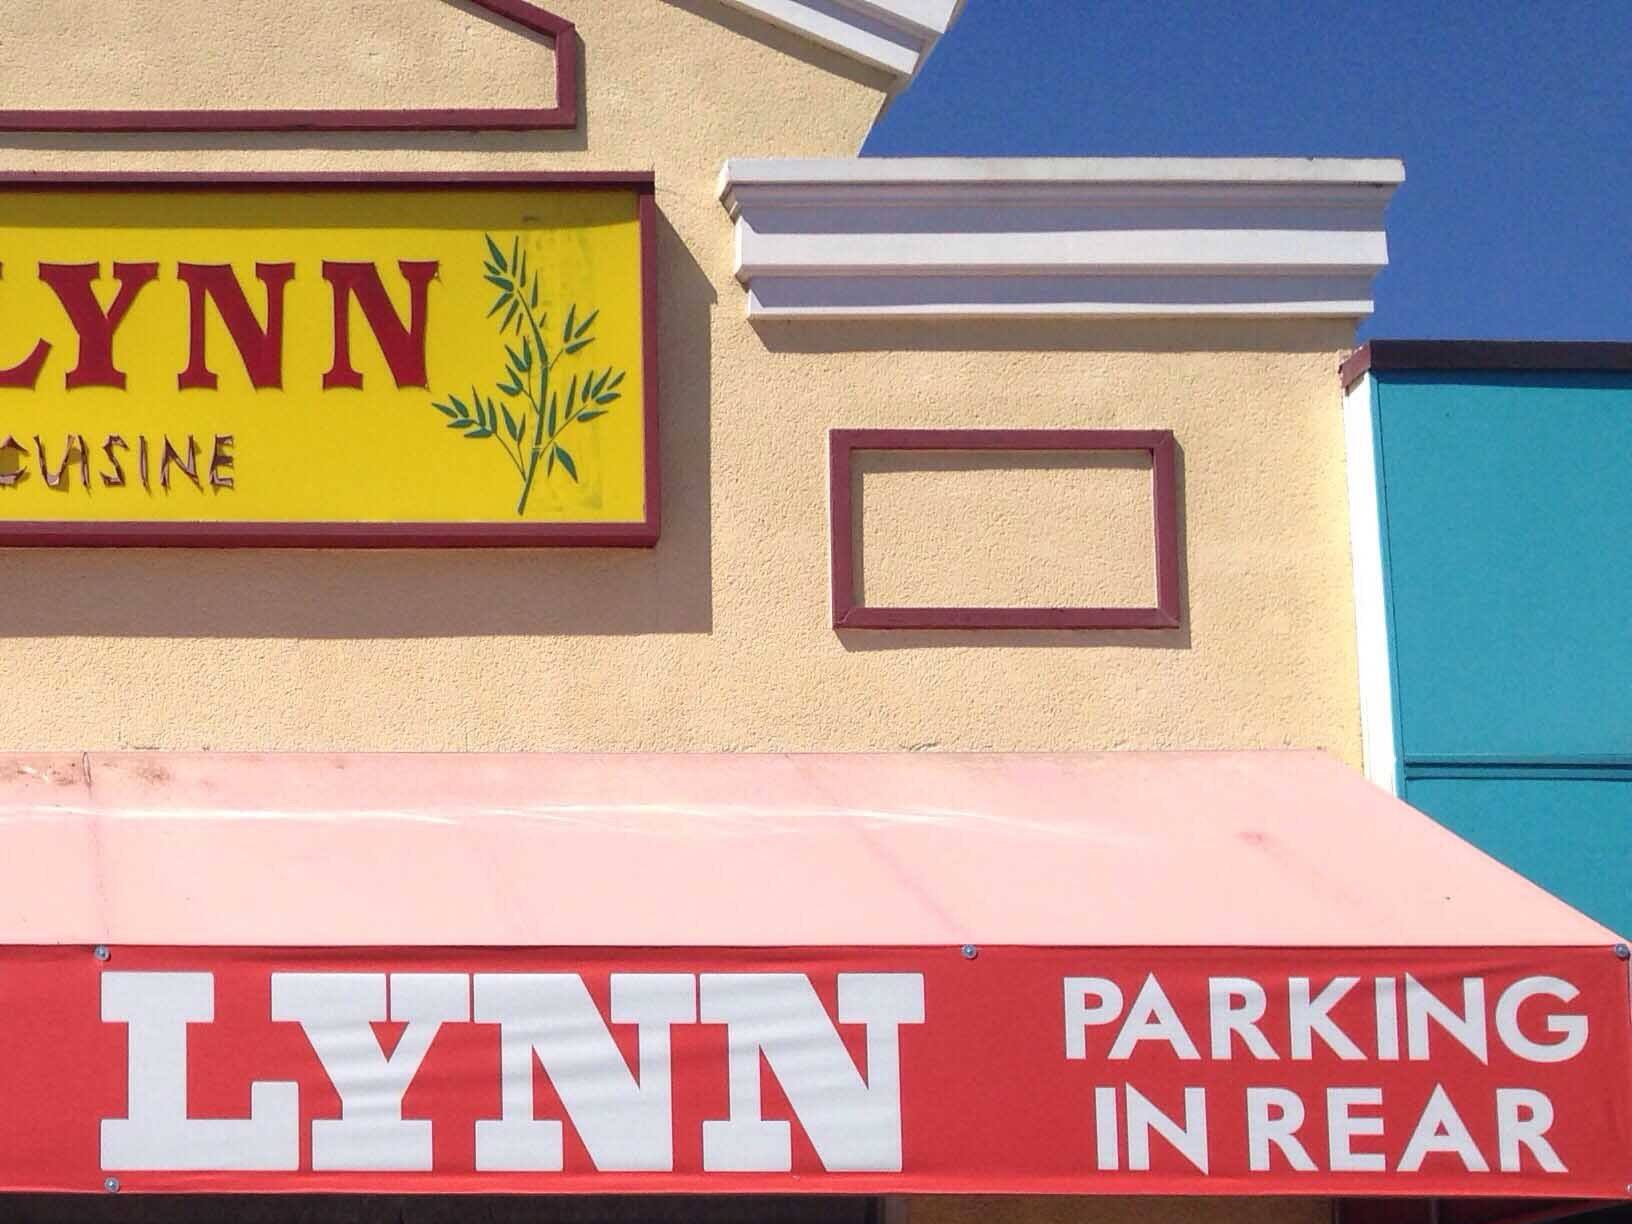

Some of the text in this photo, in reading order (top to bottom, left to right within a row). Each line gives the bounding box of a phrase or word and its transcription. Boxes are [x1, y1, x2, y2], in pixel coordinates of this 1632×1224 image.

[1063, 972, 1589, 1065] PARKING
[100, 971, 926, 1174] LYNN
[1095, 1082, 1568, 1175] IN REAR
